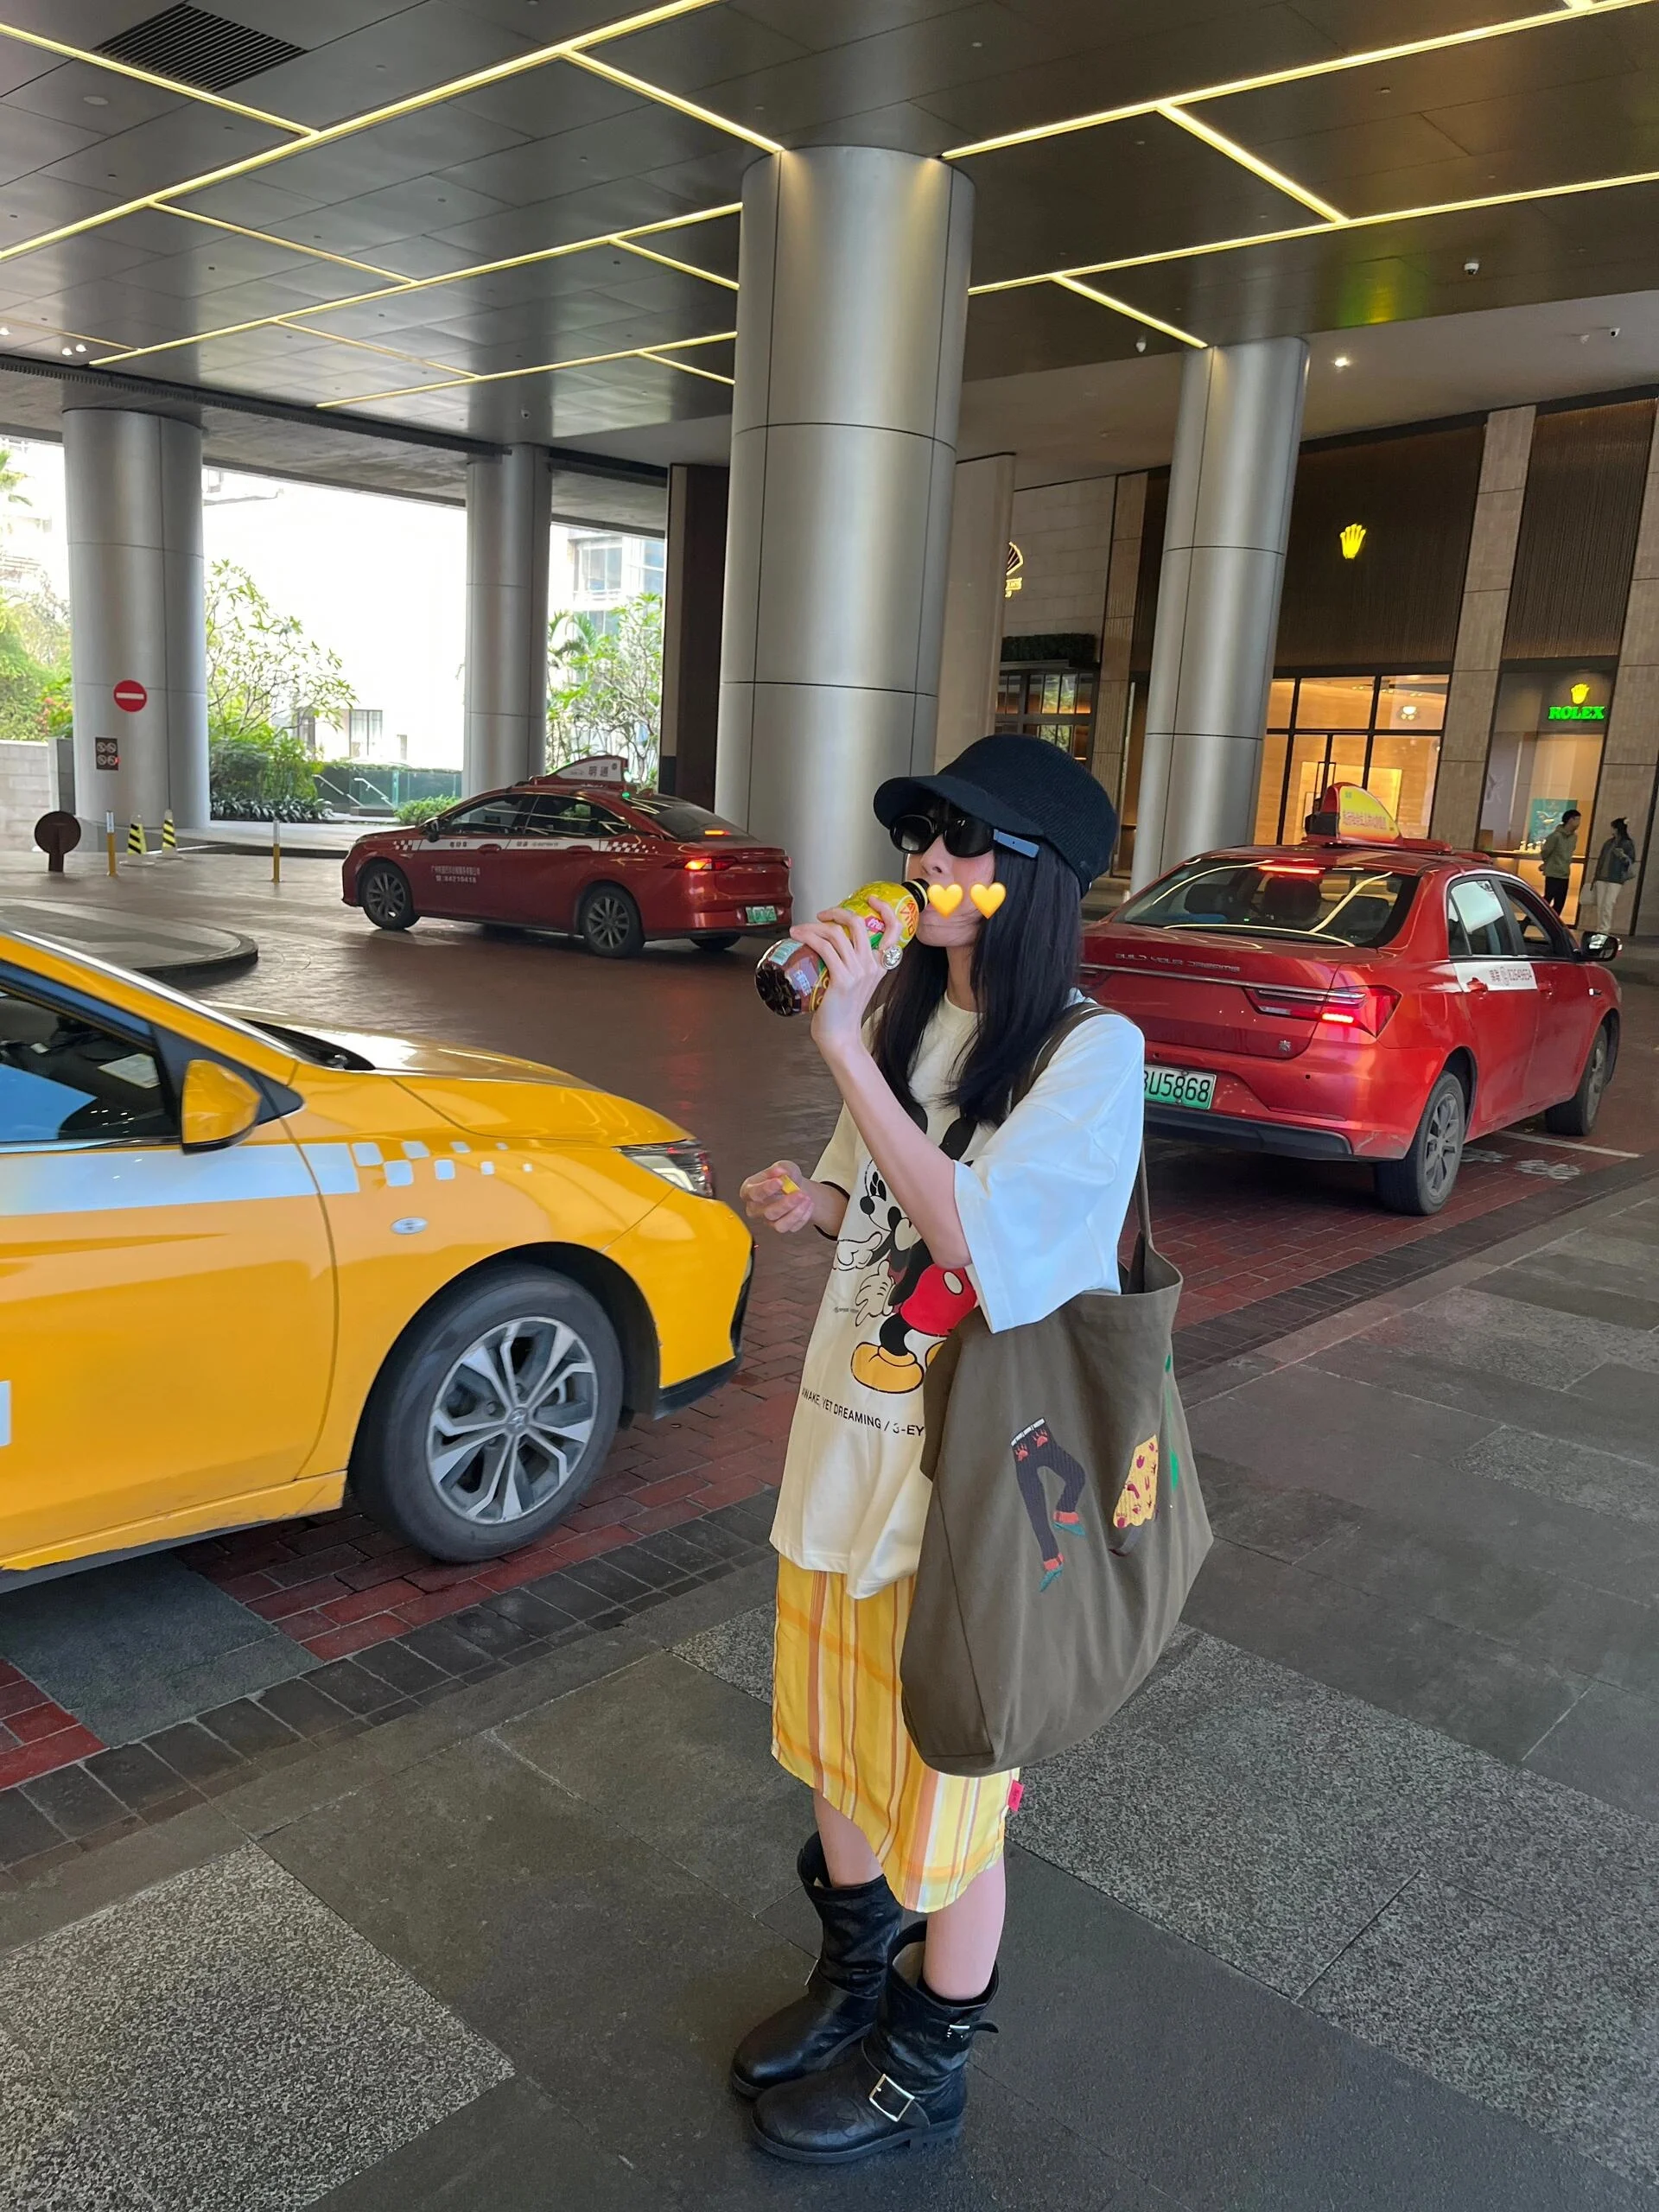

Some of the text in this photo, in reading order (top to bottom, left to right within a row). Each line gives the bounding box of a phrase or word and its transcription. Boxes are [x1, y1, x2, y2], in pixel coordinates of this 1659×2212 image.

[1548, 705, 1605, 720] ROLEX
[822, 1397, 833, 1412] YET
[833, 1404, 881, 1429] DREAMING
